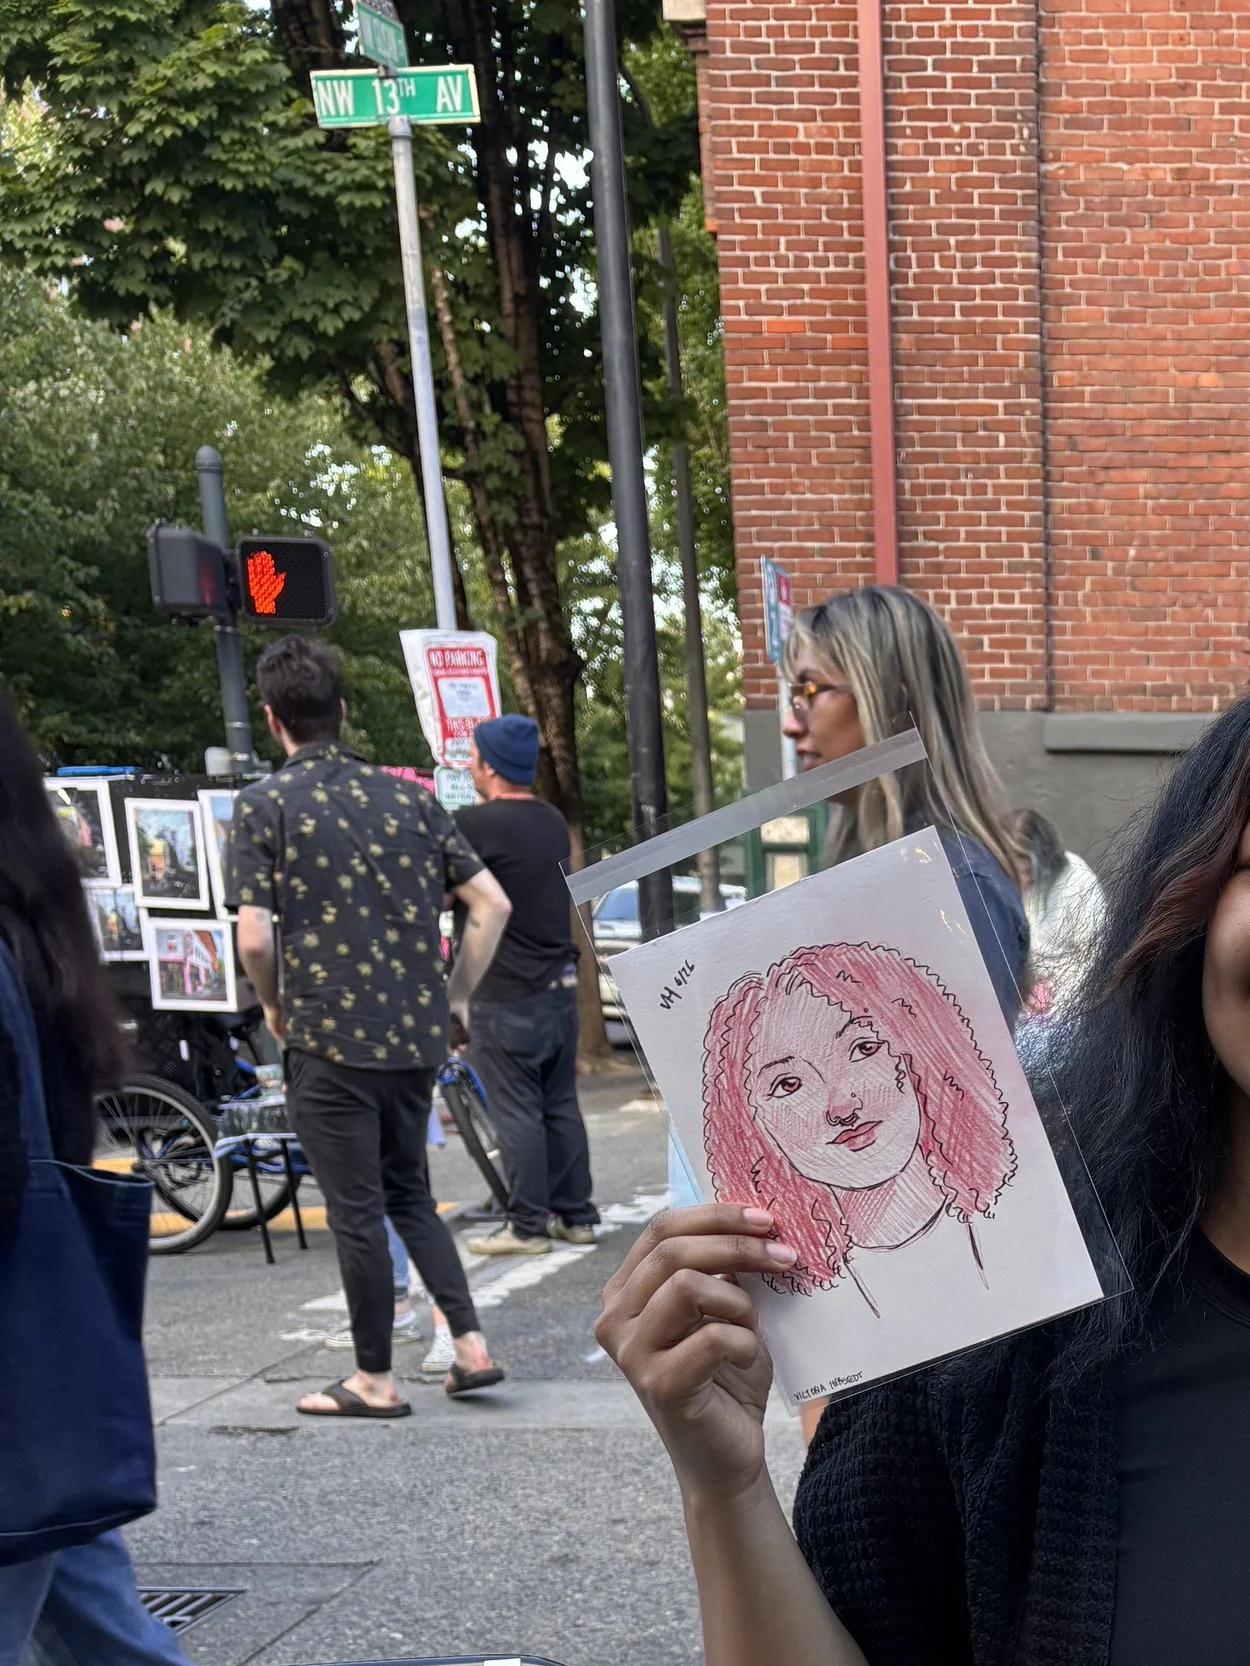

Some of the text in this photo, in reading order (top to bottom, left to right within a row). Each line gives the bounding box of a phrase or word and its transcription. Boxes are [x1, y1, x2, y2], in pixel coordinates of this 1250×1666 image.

[316, 75, 463, 117] NW 13TH AV
[429, 650, 484, 668] NO PARKING
[793, 1383, 826, 1400] VICTORIA
